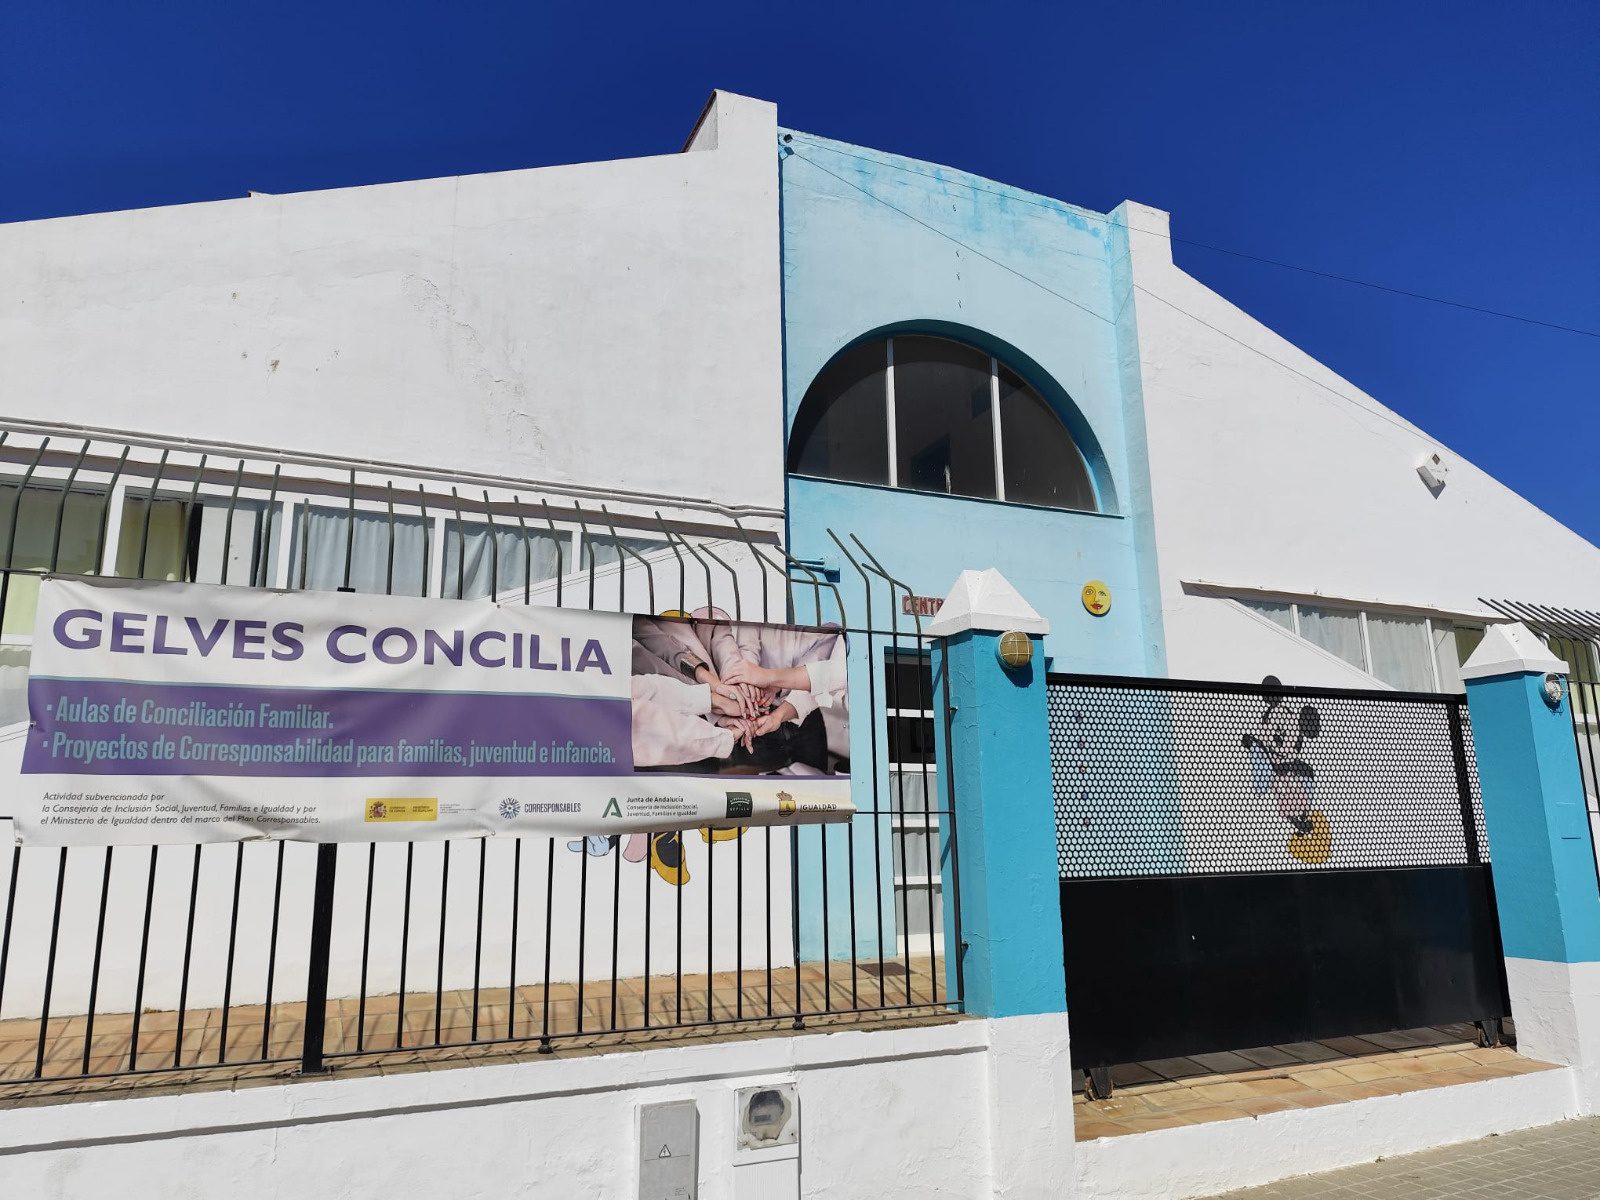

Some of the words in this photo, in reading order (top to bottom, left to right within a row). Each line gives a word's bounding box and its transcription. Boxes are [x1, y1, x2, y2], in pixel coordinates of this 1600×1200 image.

[52, 608, 305, 662] GELVES
[326, 624, 613, 676] CONCILIA
[55, 696, 109, 723] Aulas
[113, 698, 136, 723] de
[141, 699, 255, 728] Conciliación
[259, 703, 334, 729] Familiar.
[52, 731, 148, 764] Proyectos
[152, 734, 175, 760] de
[180, 735, 354, 766] Corresponsabilidad
[357, 743, 394, 767] para
[398, 737, 467, 766] familias,
[469, 739, 536, 767] juventud
[540, 744, 548, 763] e
[551, 740, 616, 764] infancia.
[43, 792, 83, 801] Actividad
[85, 792, 148, 801] subvencionada
[150, 794, 164, 802] por
[42, 804, 50, 812] la
[101, 804, 112, 813] de
[115, 804, 152, 813] Inclusión
[155, 804, 180, 814] Social,
[181, 804, 218, 814] Juventud,
[220, 804, 251, 812] Familias
[261, 804, 295, 814] Igualdad
[296, 806, 301, 814] y
[303, 805, 316, 813] por
[524, 803, 582, 813] CORRESPONSABLES
[40, 816, 48, 824] el
[50, 816, 94, 824] Ministerio
[97, 816, 108, 824] de
[111, 816, 149, 826] Igualdad
[150, 815, 178, 824] dentro
[180, 815, 193, 823] del
[222, 814, 235, 822] del
[237, 814, 254, 822] Plan
[256, 814, 321, 824] Corresponsables.
